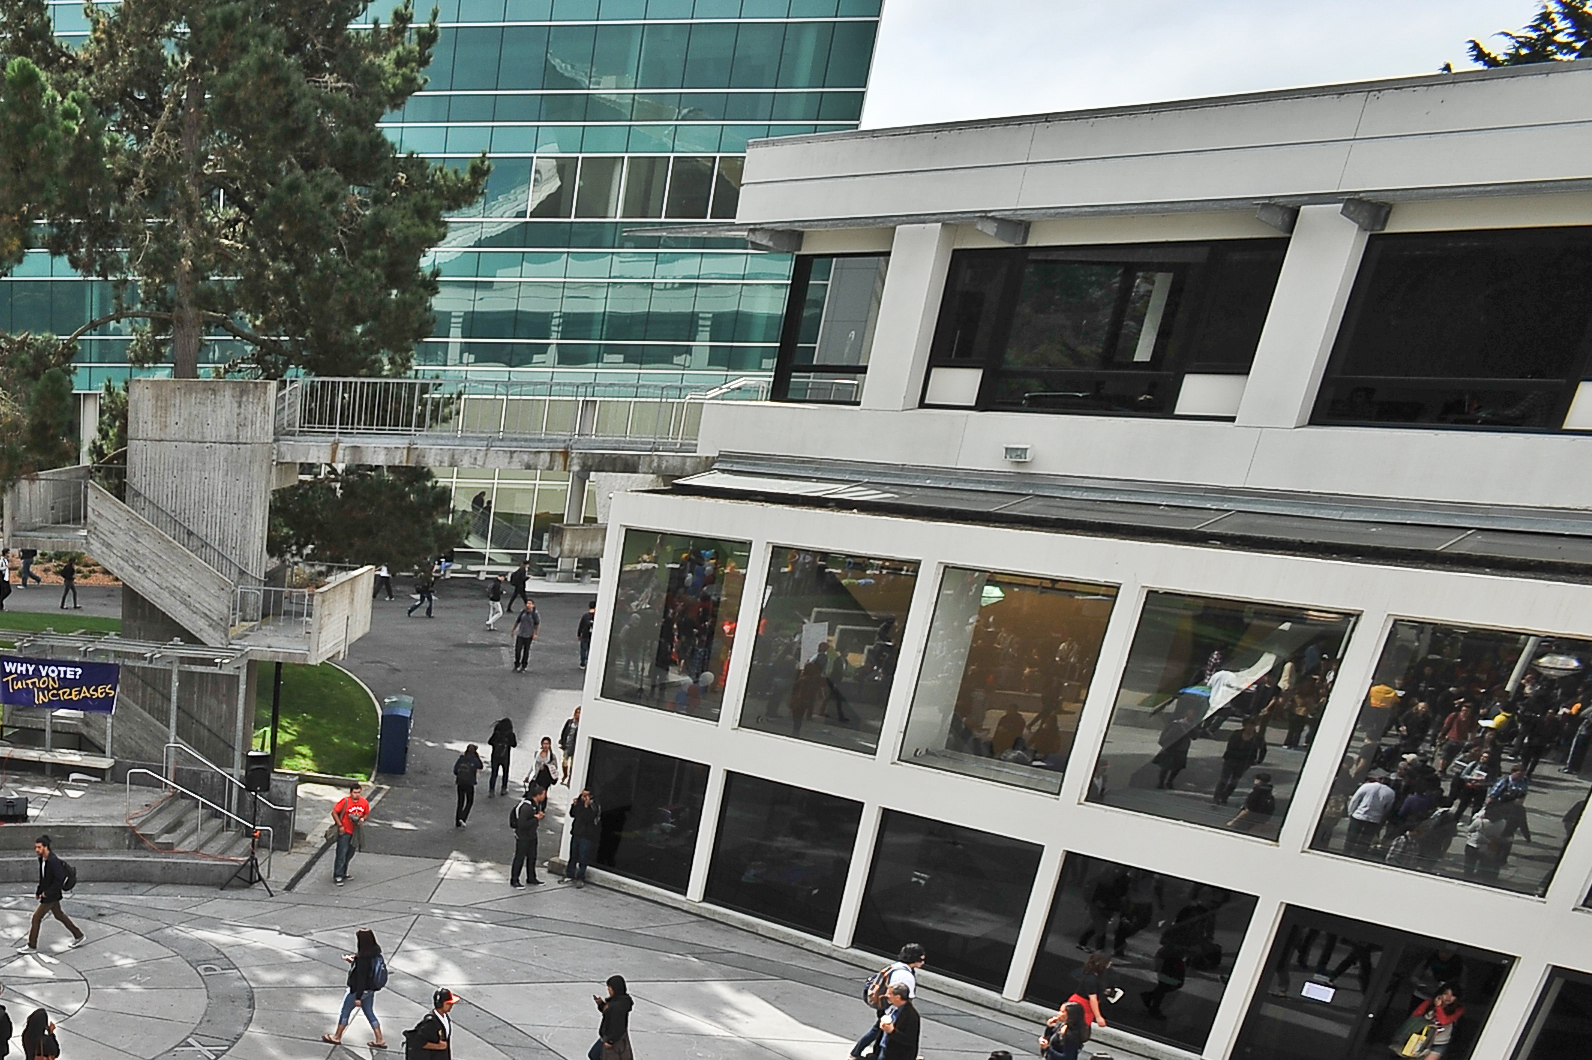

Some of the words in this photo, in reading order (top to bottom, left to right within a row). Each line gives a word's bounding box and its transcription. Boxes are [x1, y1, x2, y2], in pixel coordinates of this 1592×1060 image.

[3, 661, 36, 675] WHY
[39, 664, 83, 679] VOTE?
[34, 684, 115, 705] INCREASES
